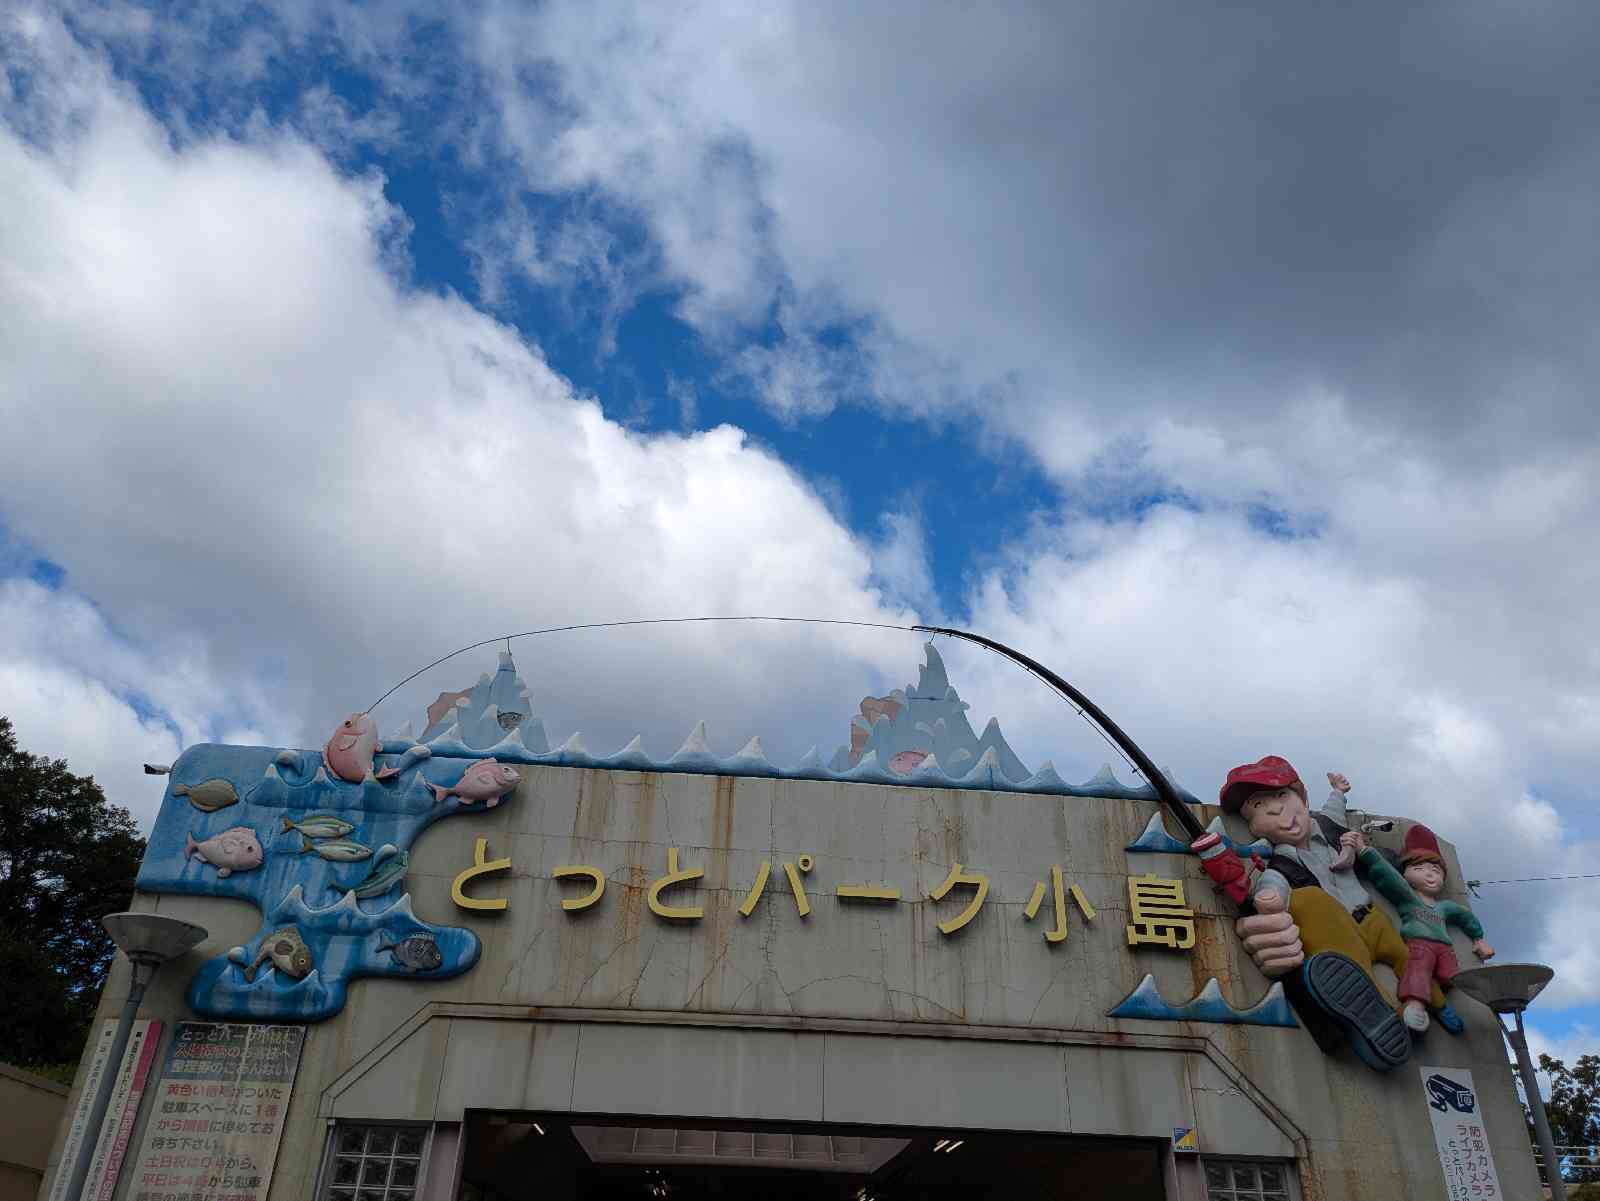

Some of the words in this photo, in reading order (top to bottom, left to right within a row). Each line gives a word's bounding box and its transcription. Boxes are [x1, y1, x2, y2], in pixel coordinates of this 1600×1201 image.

[451, 837, 1196, 949] とっとパーク小島
